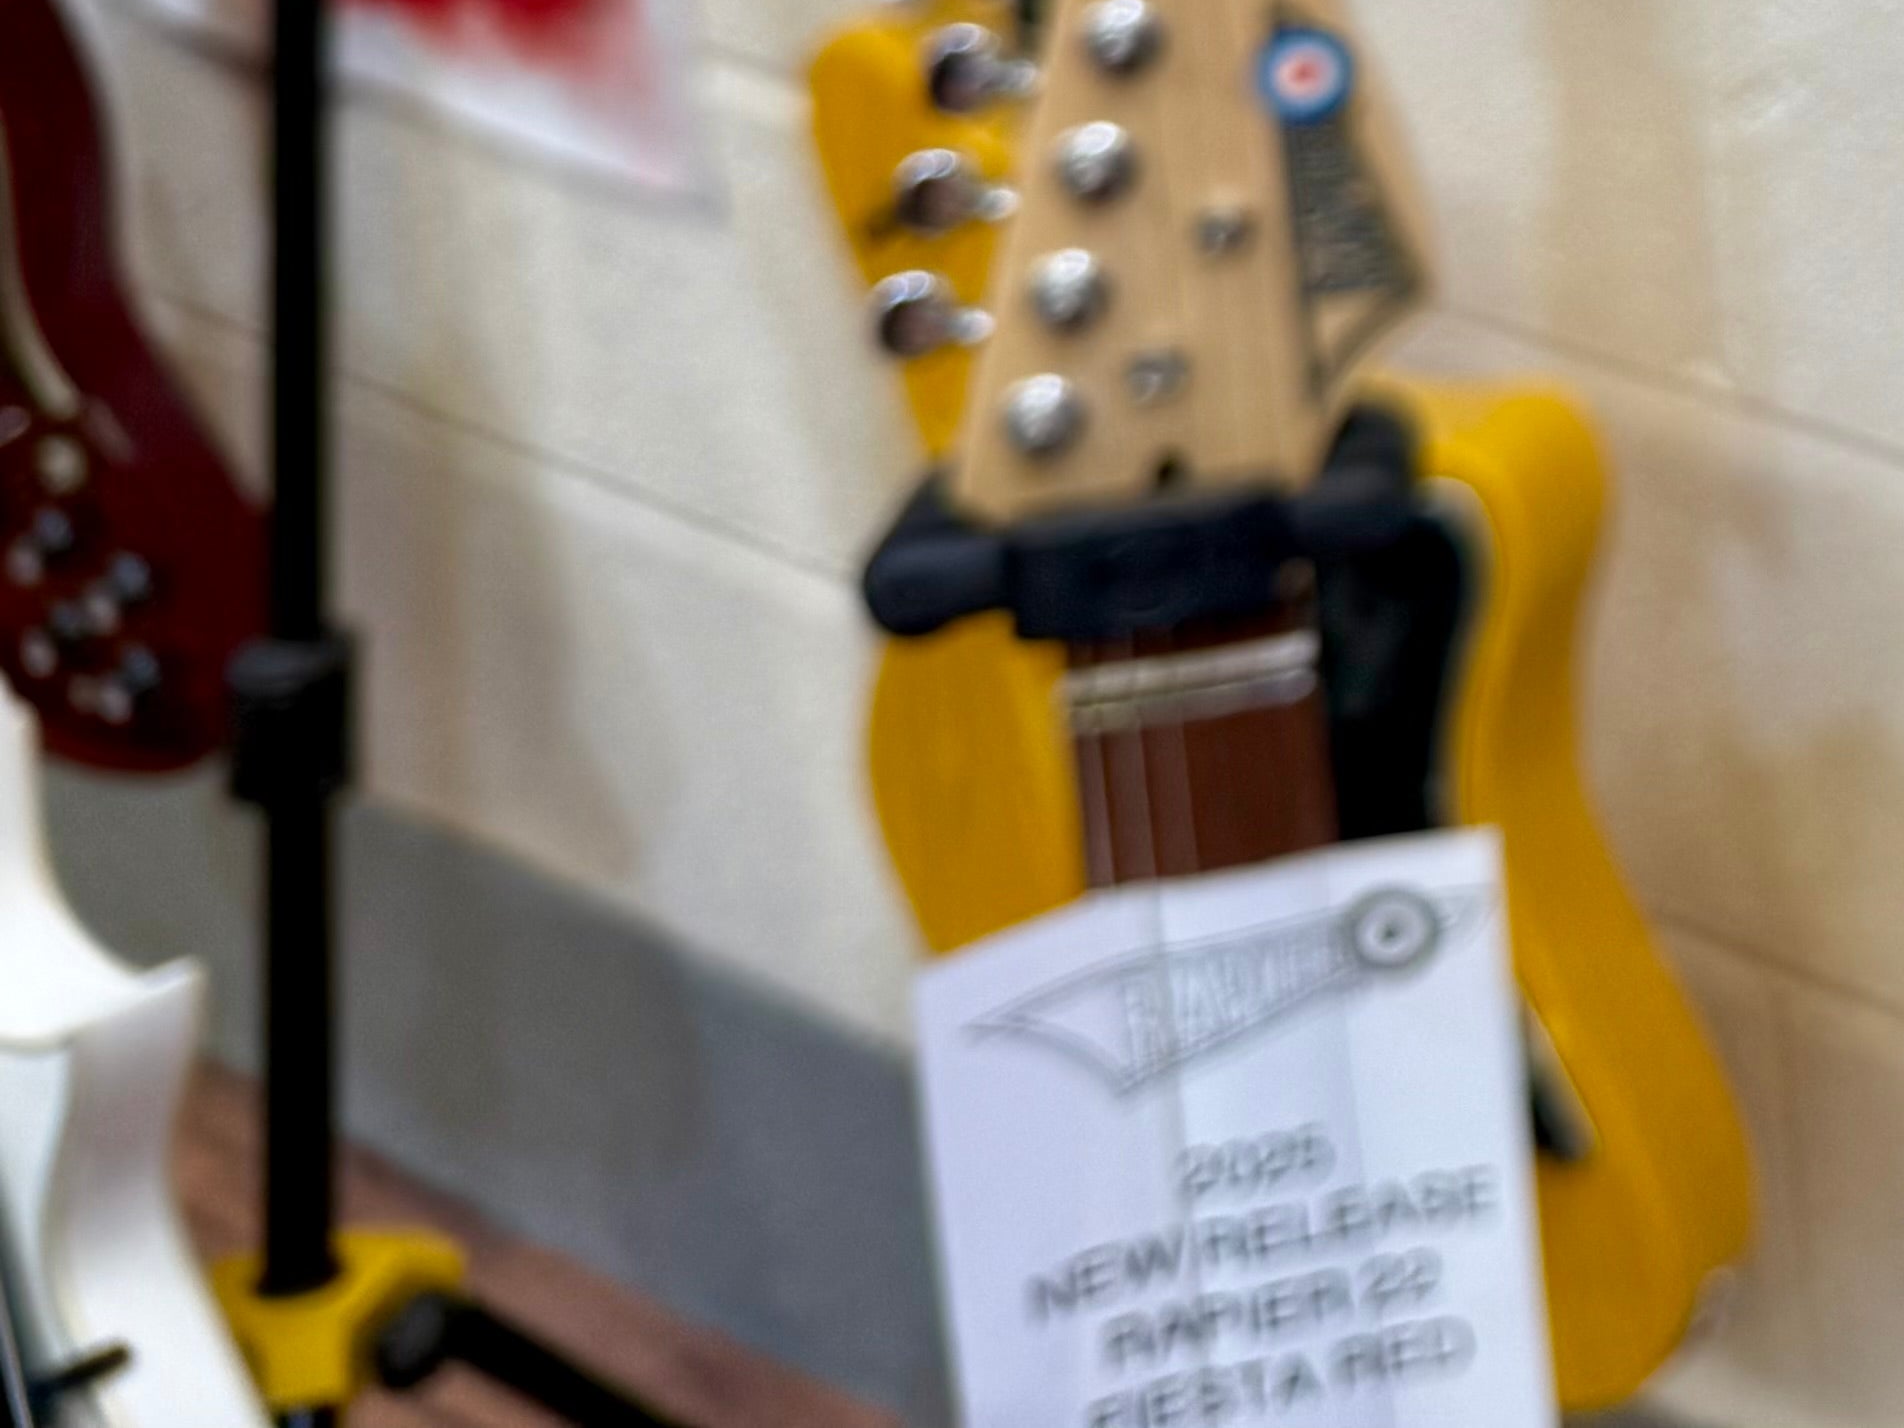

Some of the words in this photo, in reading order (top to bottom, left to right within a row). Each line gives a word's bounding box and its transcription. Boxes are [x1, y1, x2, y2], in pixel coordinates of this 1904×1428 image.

[1026, 1220, 1189, 1326] NEW
[1191, 1162, 1500, 1268] RELEASE
[1101, 1266, 1355, 1370] RAPIER
[1326, 1314, 1478, 1392] RED
